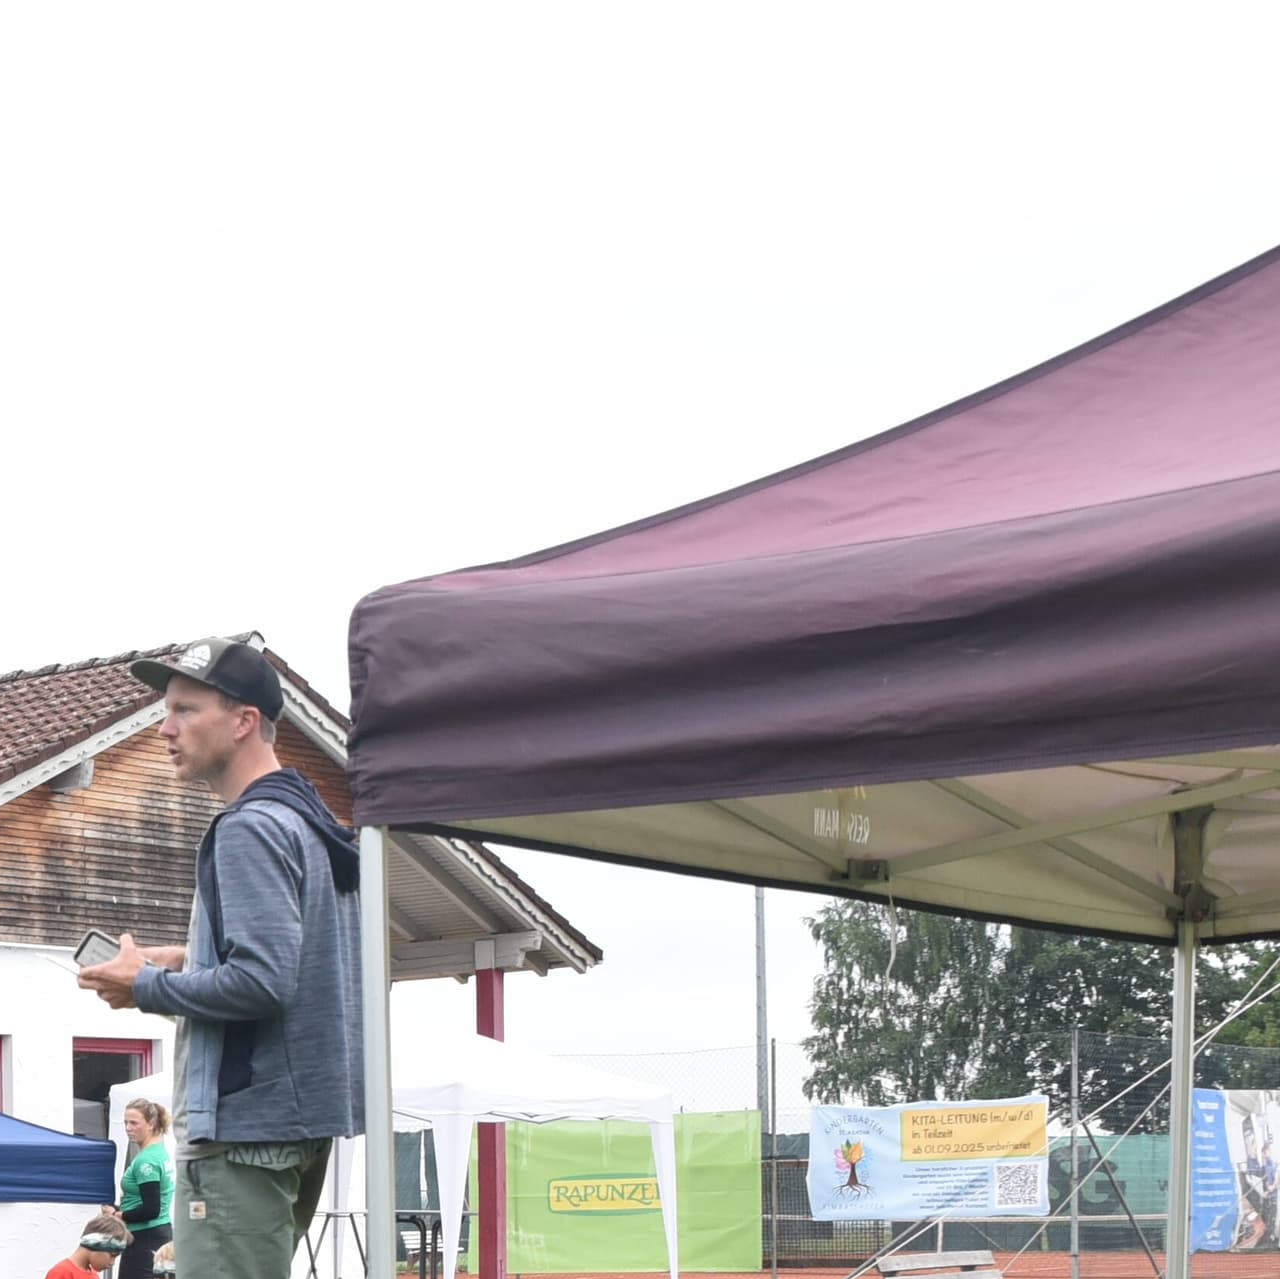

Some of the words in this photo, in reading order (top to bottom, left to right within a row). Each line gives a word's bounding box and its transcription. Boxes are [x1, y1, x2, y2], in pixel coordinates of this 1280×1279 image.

[912, 1113, 987, 1126] KITA-LEITUNG
[990, 1111, 1033, 1122] (m/w/d)
[912, 1130, 920, 1139] in
[924, 1128, 952, 1139] Teilzeit
[912, 1146, 922, 1154] ab
[924, 1143, 984, 1154] 01.09.2025
